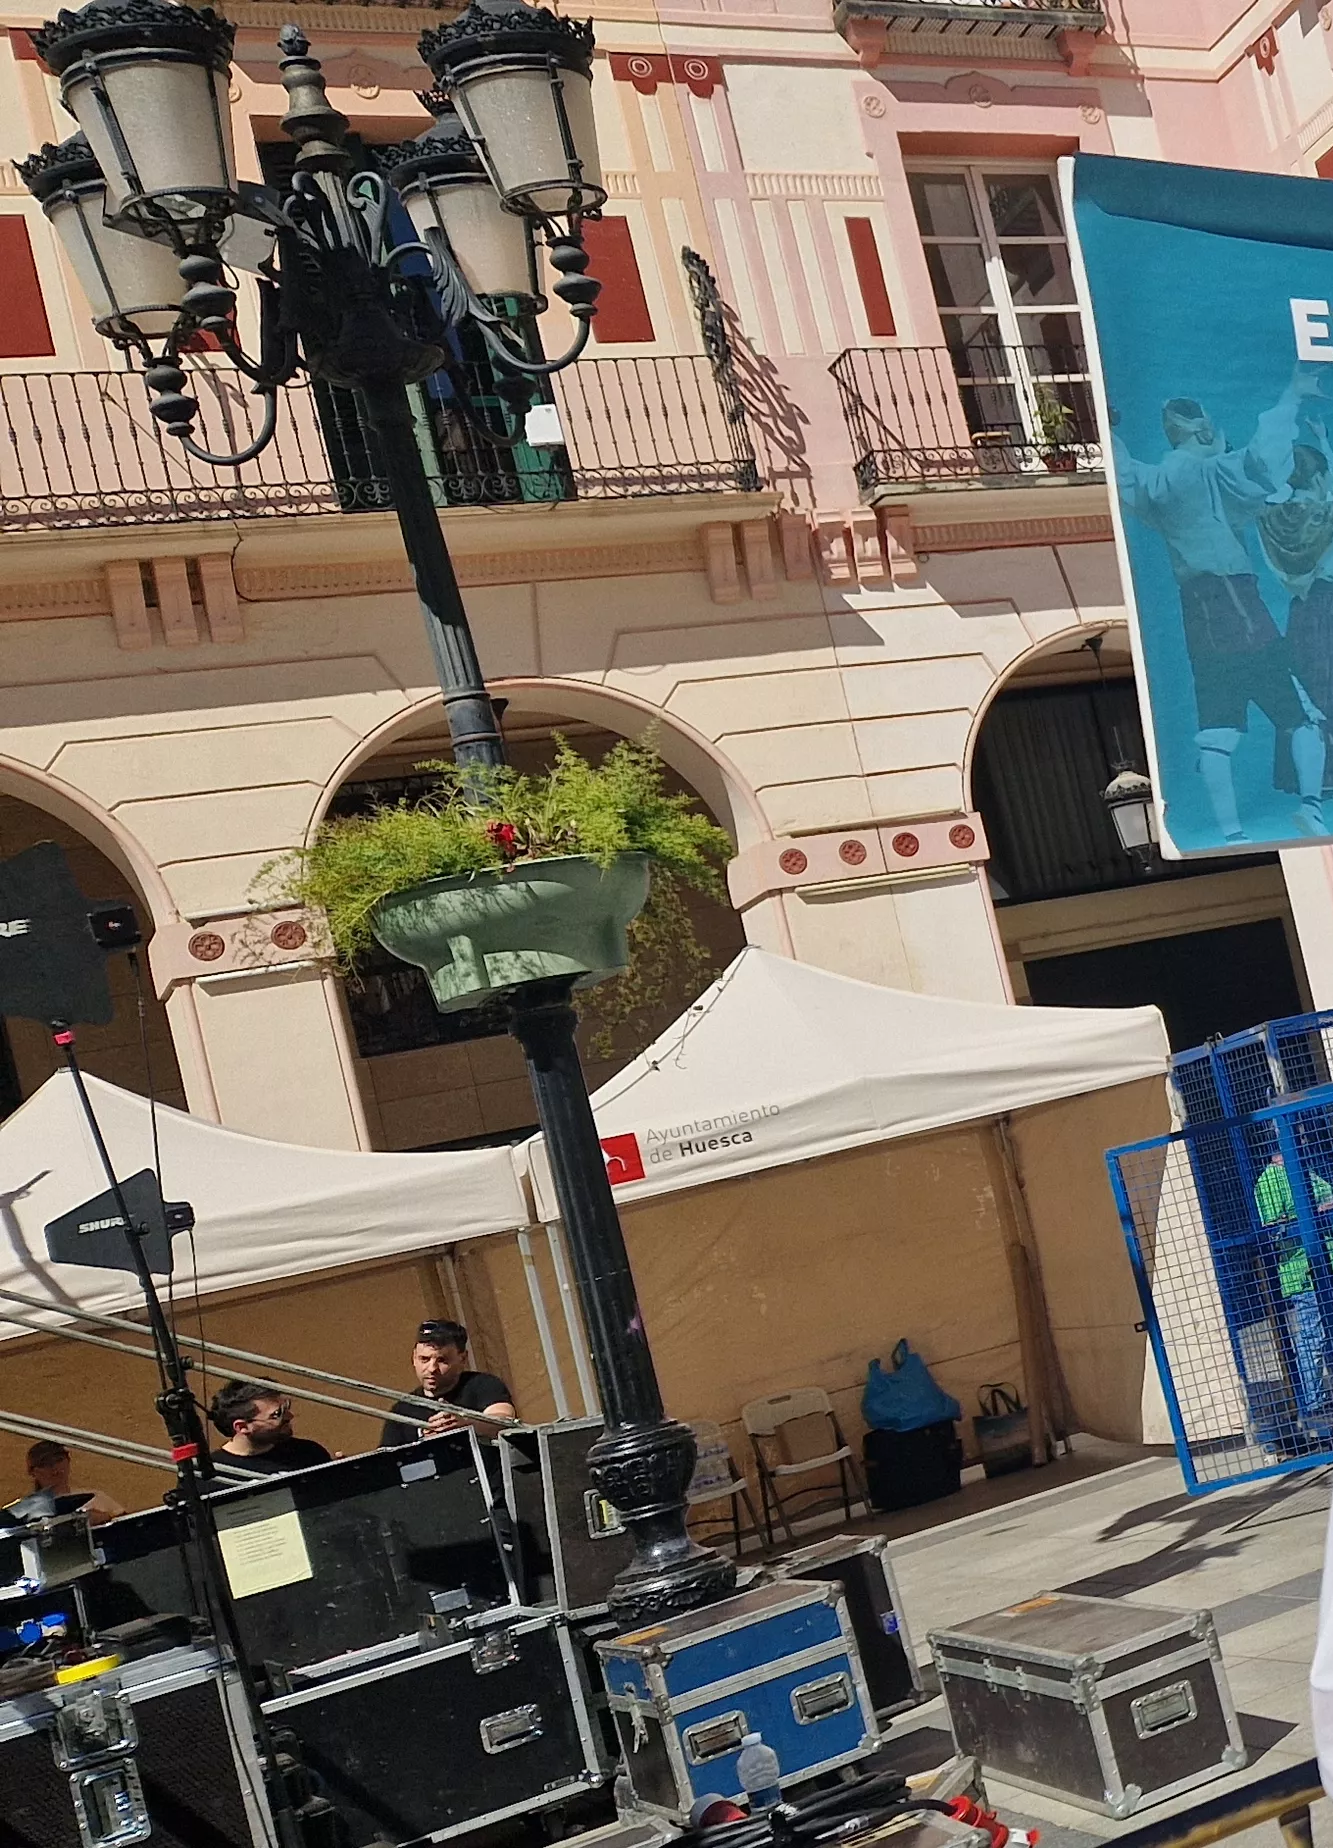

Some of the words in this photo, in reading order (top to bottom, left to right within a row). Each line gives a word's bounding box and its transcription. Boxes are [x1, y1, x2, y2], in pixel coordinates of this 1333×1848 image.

[646, 1103, 781, 1146] Ayuntamiento
[650, 1150, 673, 1165] de
[679, 1130, 753, 1158] Huesca
[78, 1214, 132, 1235] SHUR
